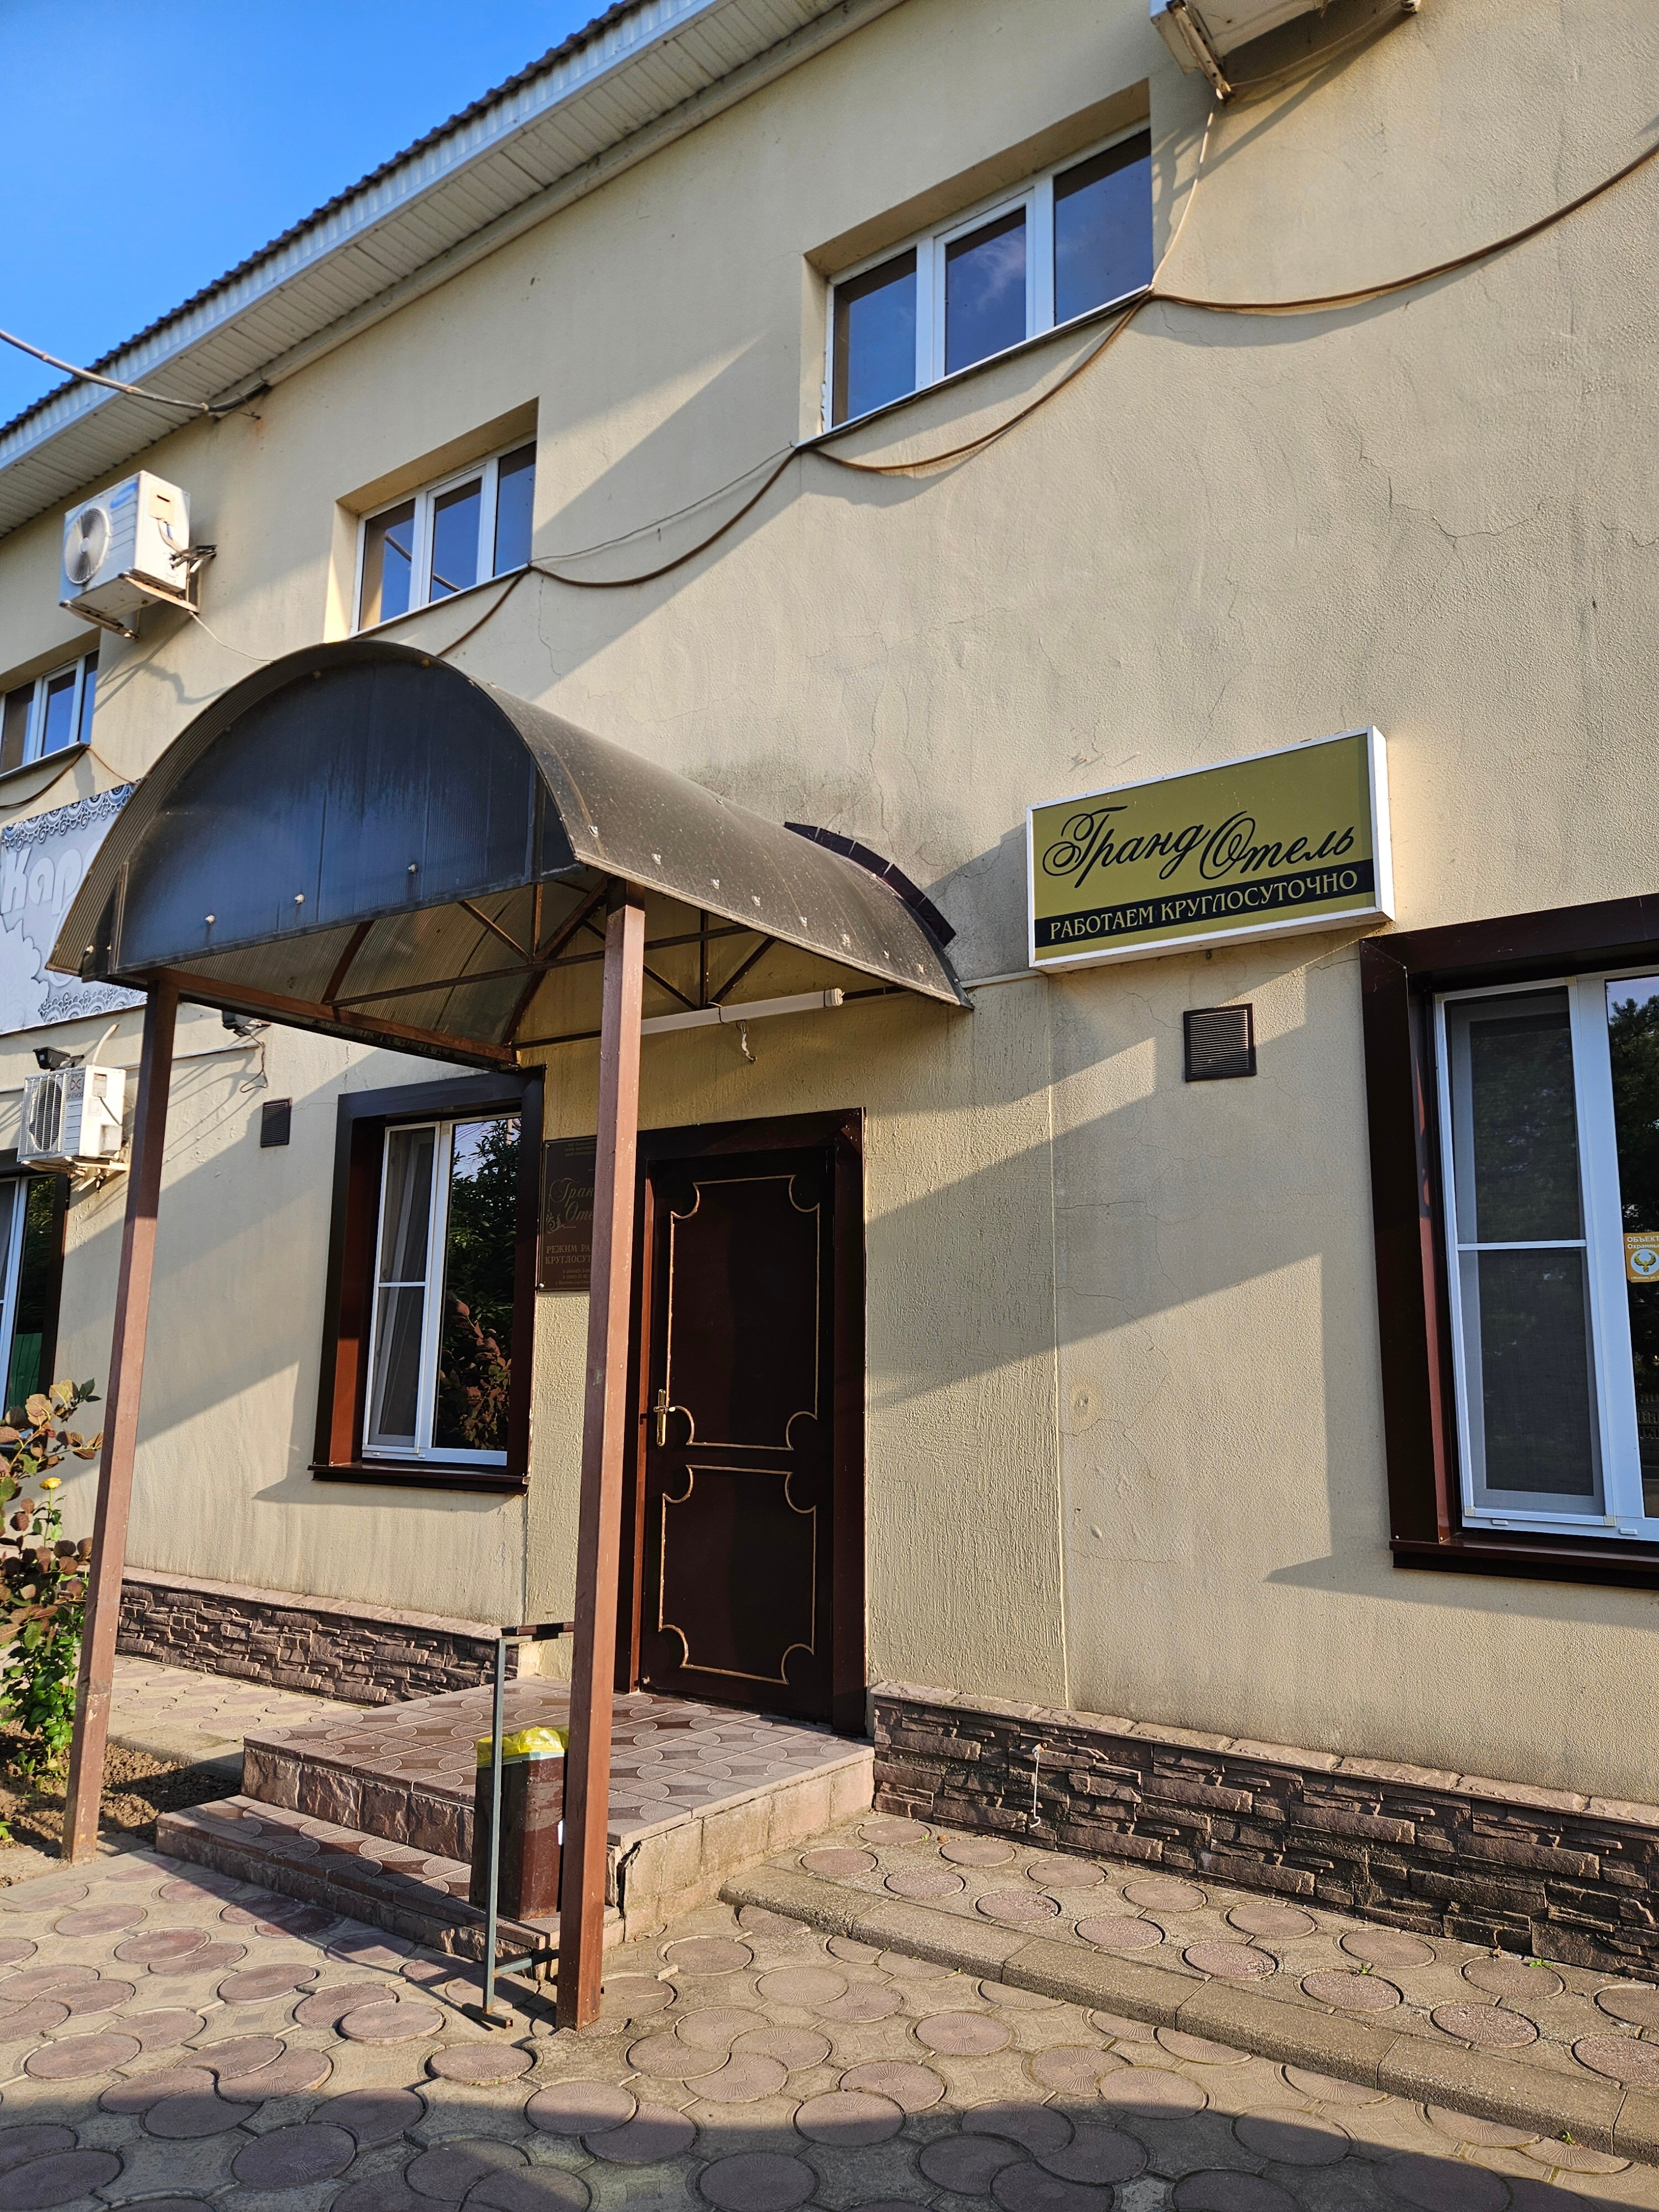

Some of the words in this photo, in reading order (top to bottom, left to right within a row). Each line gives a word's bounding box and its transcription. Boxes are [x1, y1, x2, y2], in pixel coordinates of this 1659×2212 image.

[1042, 806, 1210, 888] Гранд
[1199, 811, 1354, 880] Отель
[1050, 906, 1154, 940] РАБОТАЕМ
[1161, 870, 1357, 920] КРУГЛОСУТОЧНО
[546, 1245, 577, 1253] РЕЖИМ
